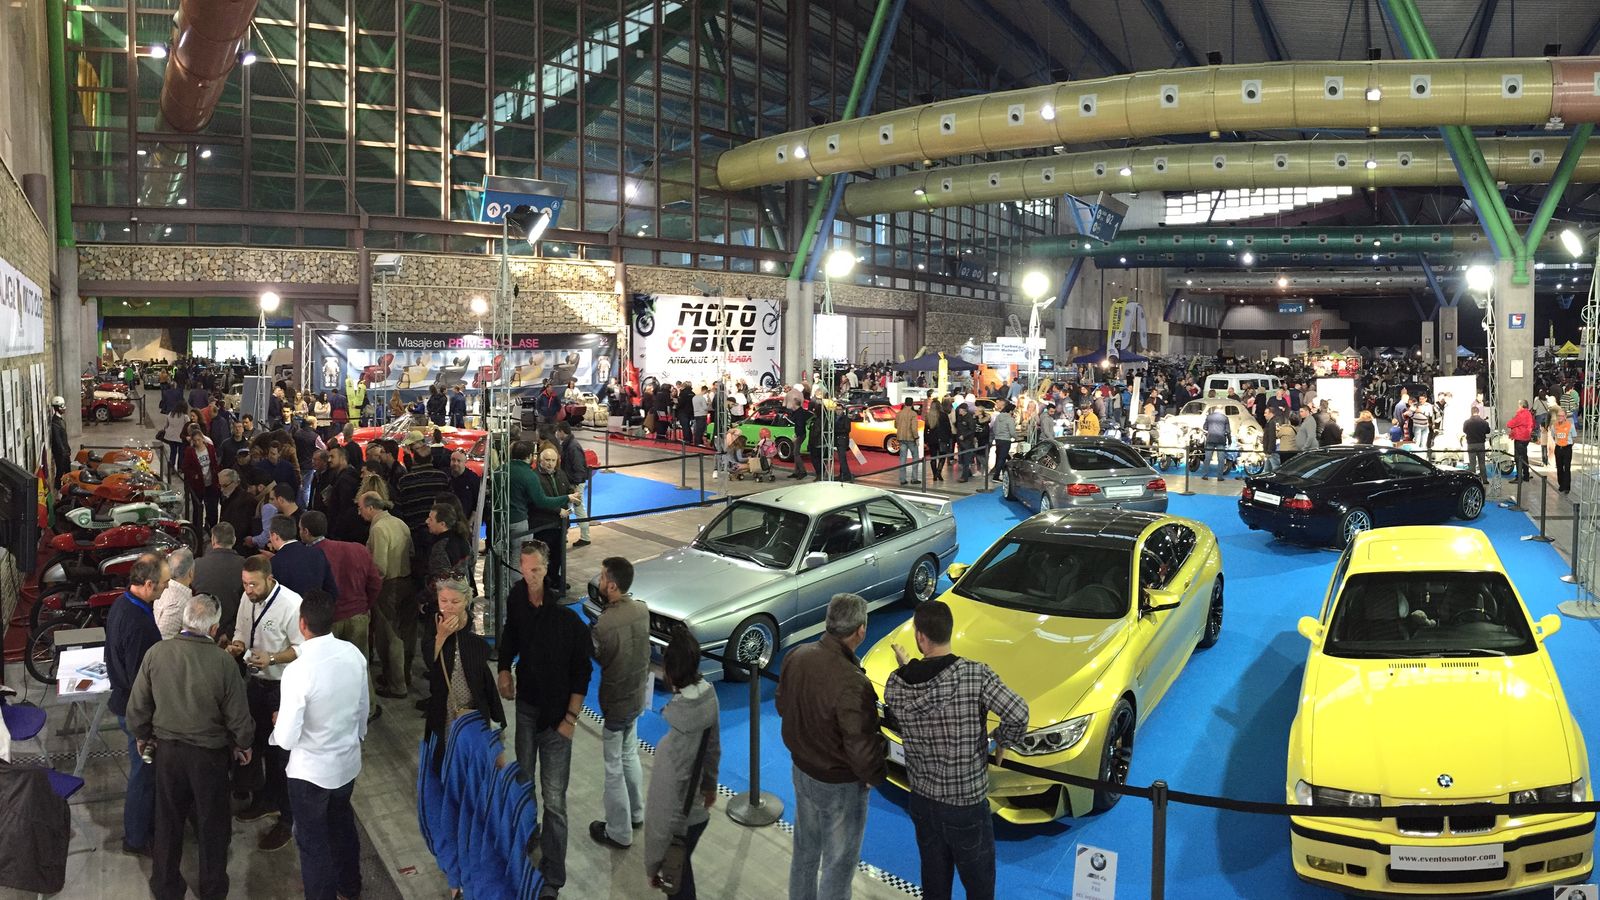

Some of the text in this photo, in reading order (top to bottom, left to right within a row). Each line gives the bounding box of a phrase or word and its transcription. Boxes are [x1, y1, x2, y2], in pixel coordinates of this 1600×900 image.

[678, 303, 757, 327] MOTO
[397, 337, 433, 350] Masaje
[433, 339, 446, 348] en
[448, 339, 499, 349] PRIMERA
[690, 329, 757, 352] BIKE
[1398, 853, 1497, 863] www.eventosmotor.com
